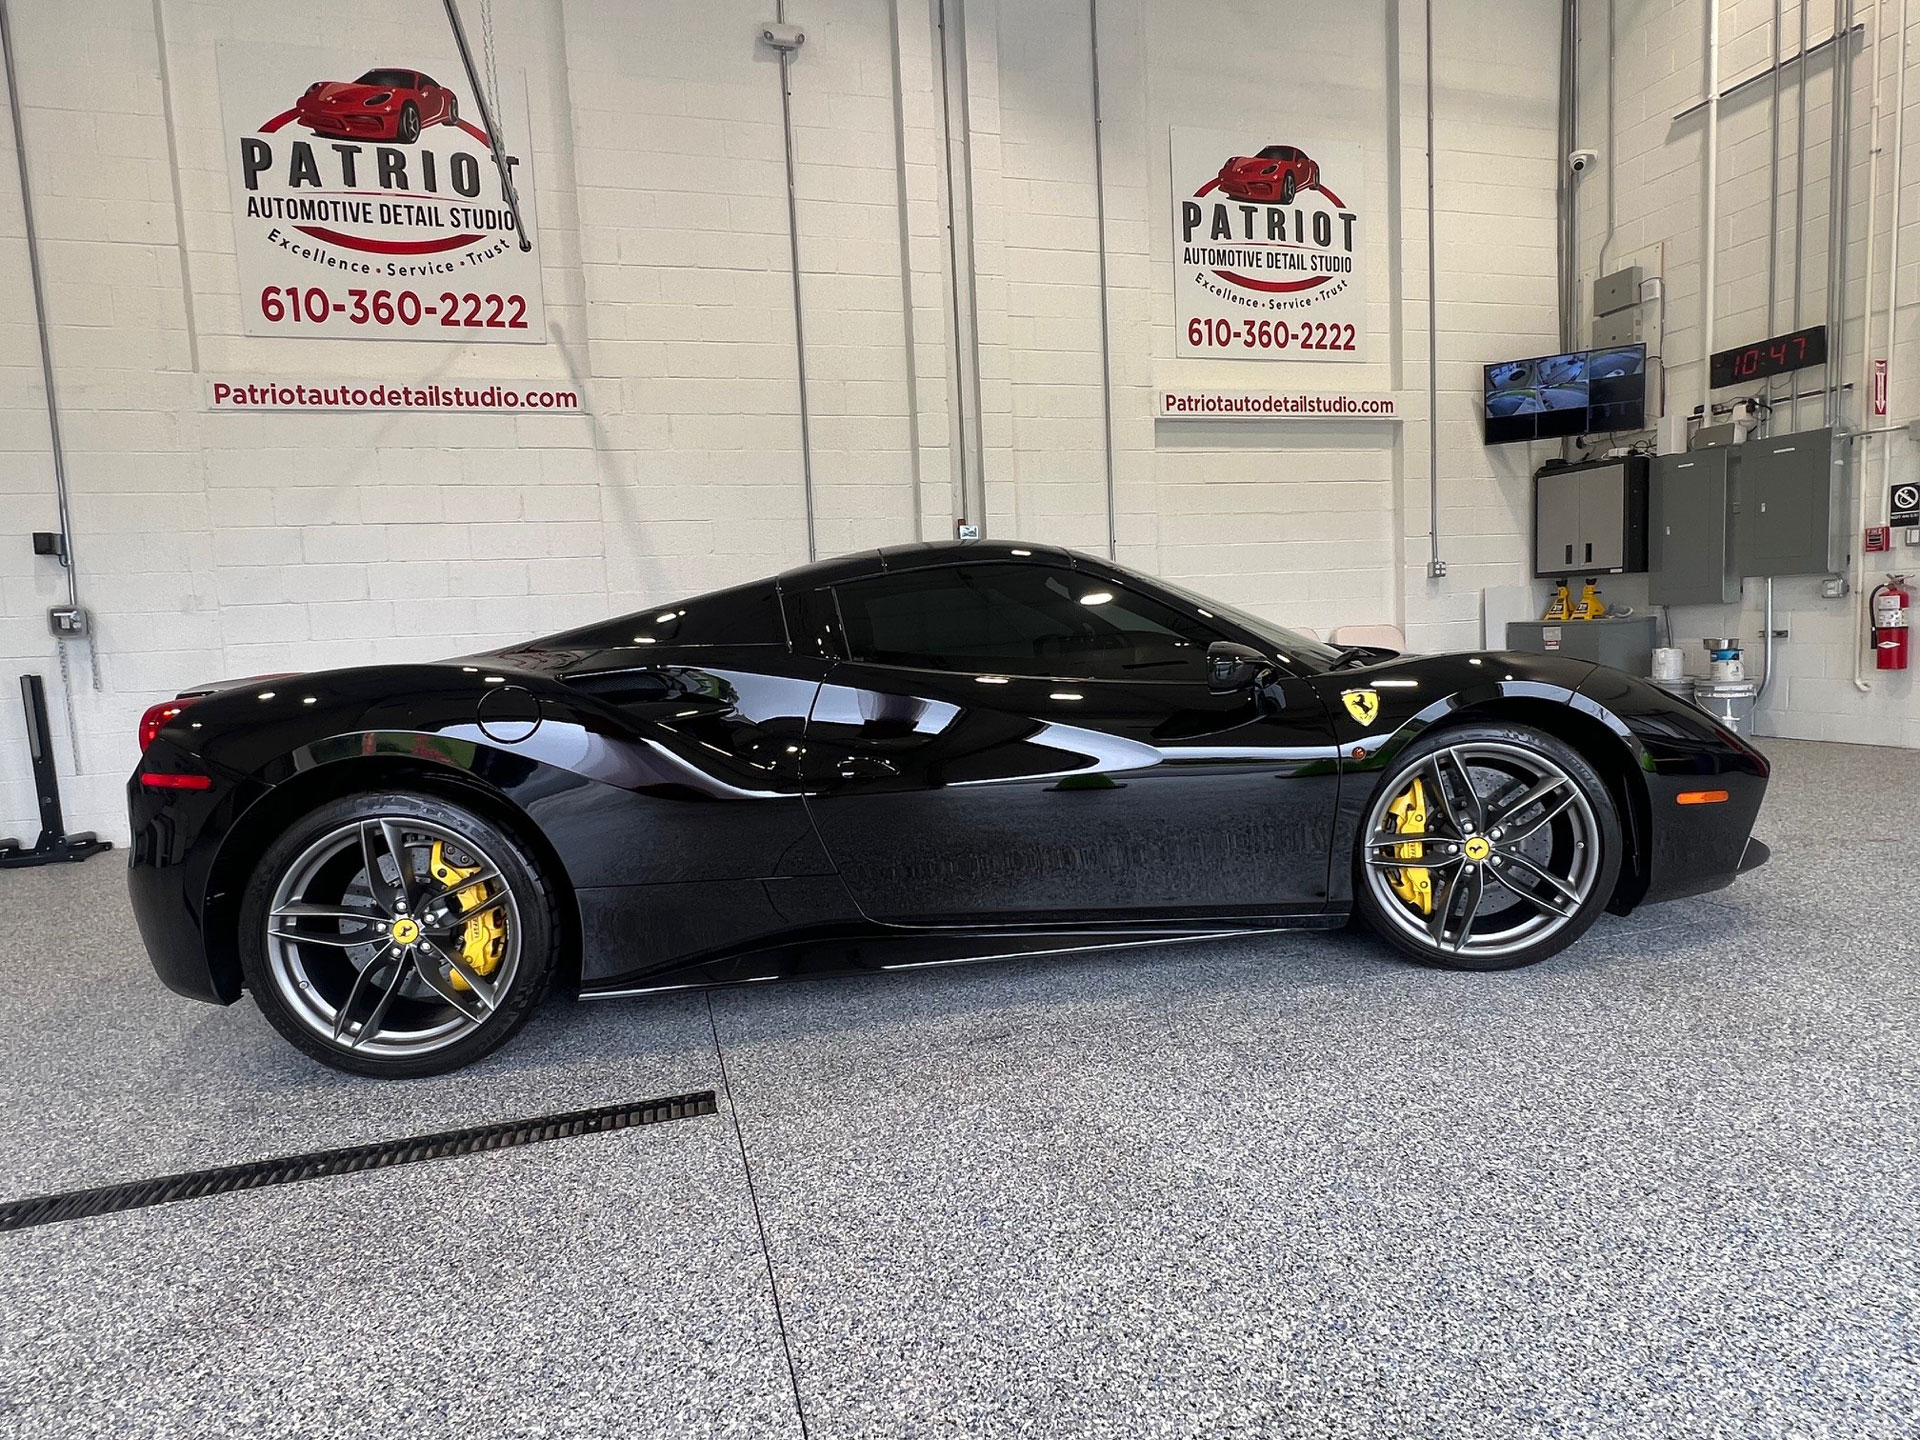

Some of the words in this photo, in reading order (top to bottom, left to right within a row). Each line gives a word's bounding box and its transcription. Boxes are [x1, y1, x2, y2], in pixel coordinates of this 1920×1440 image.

[247, 196, 374, 226] AUTOMOTIVE
[380, 203, 445, 228] DETAIL
[450, 208, 515, 231] STUDIO
[1182, 201, 1356, 252] PATRIOT
[267, 228, 371, 276] Excellence
[387, 260, 455, 277] Service
[466, 238, 510, 266] Trust
[1183, 246, 1263, 269] AUTOMOTIVE
[1266, 255, 1308, 271] DETAIL
[1310, 255, 1352, 273] STUDIO
[260, 286, 529, 329] 610-360-2222
[1194, 272, 1259, 308] Excellence
[1268, 299, 1312, 310] Service
[1319, 279, 1348, 301] Trust
[1188, 317, 1357, 351] 610-360-2222
[1734, 337, 1808, 376] 10:47
[213, 383, 579, 409] Patriotautodetailstudio.com
[1165, 394, 1395, 414] Patriotautodetailstudio.com
